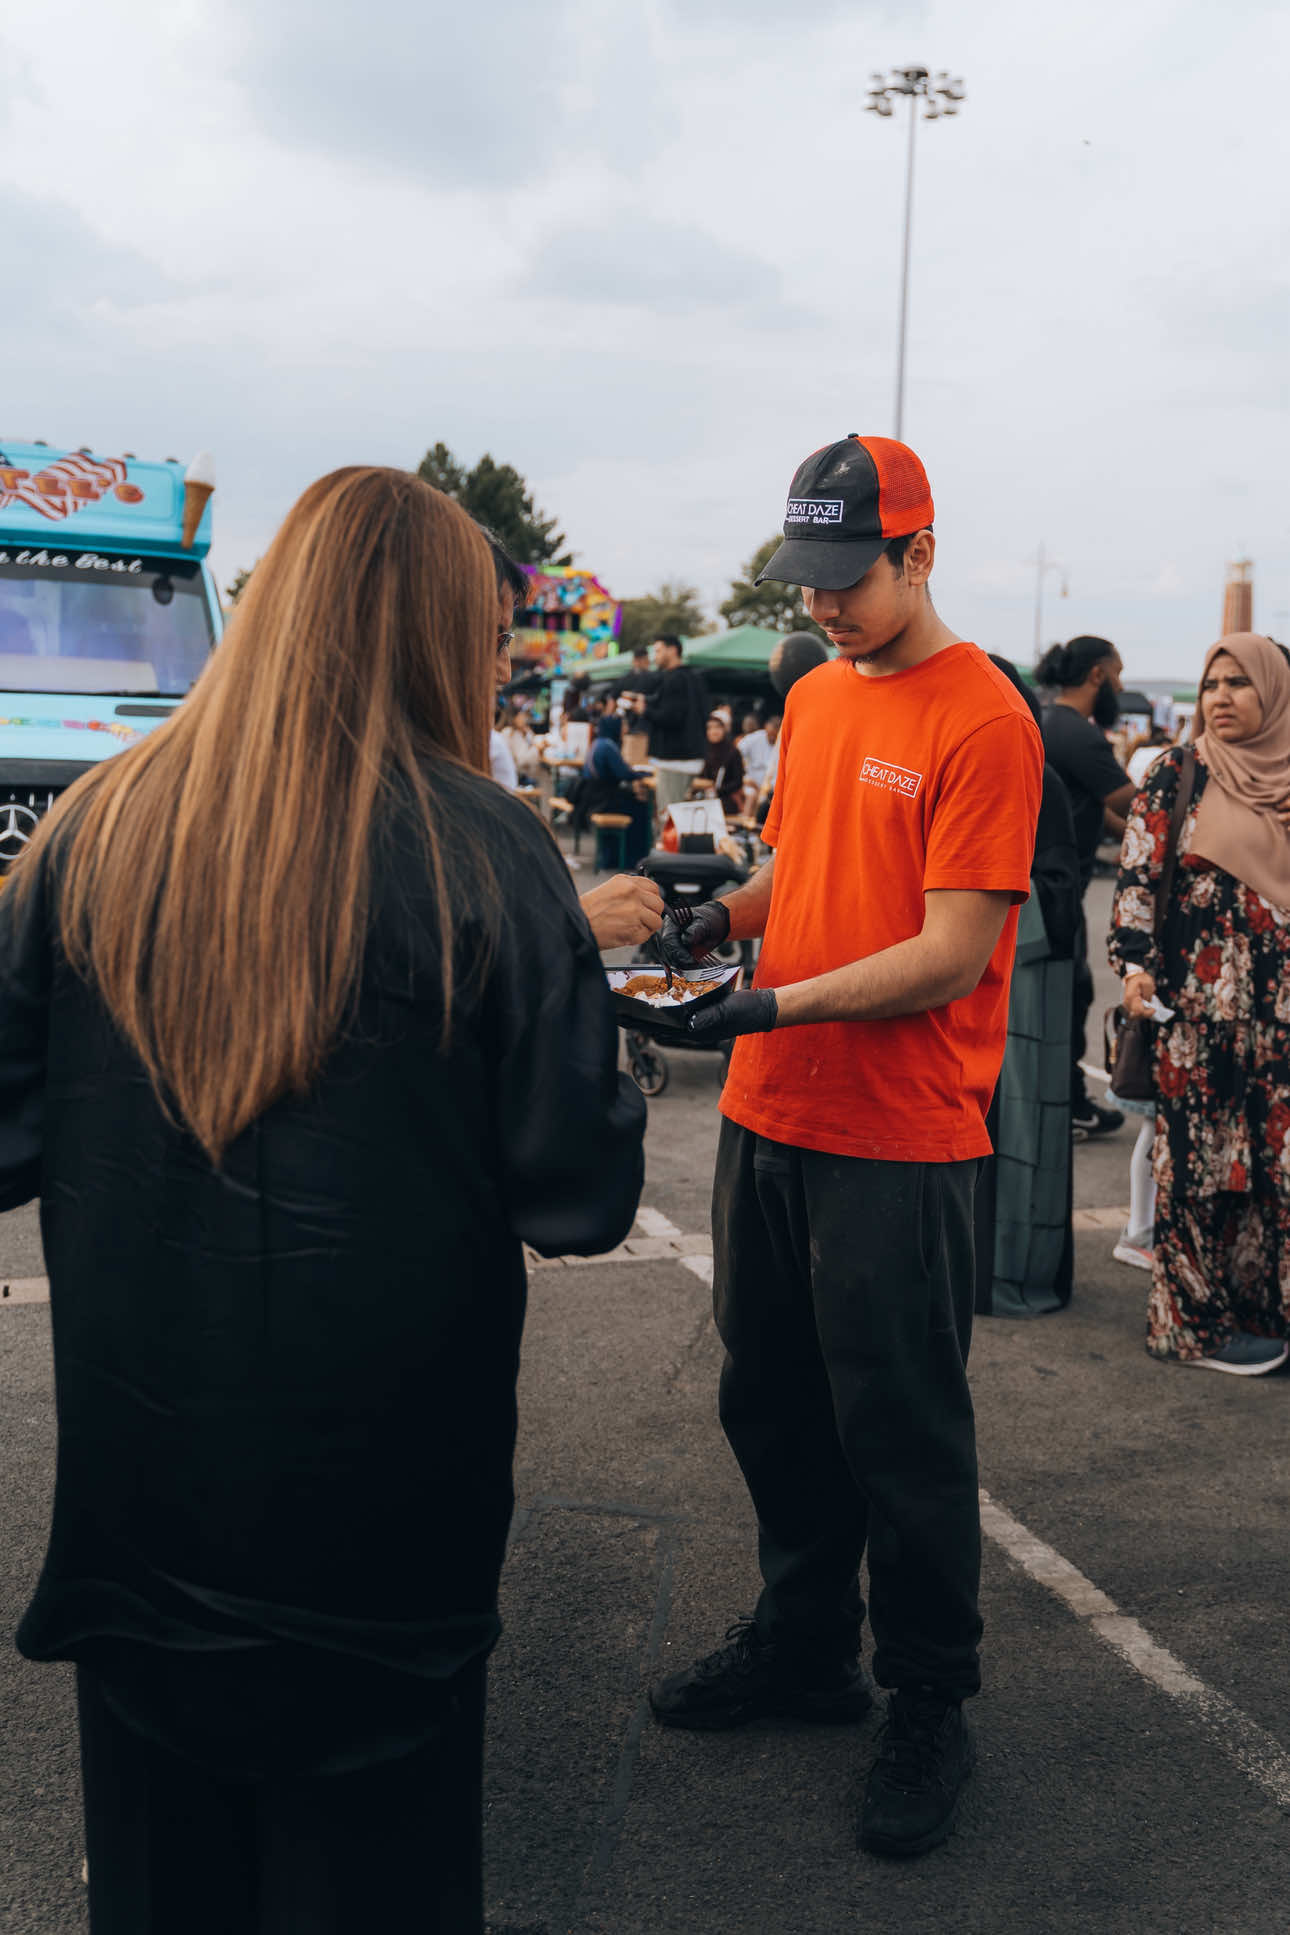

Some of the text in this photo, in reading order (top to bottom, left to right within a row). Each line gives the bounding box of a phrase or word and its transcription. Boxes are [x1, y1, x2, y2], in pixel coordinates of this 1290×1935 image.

[808, 504, 839, 516] DAZE
[813, 516, 829, 524] BAR
[15, 550, 69, 567] the
[75, 553, 142, 574] Best
[862, 763, 917, 791] CHEAT DAZE
